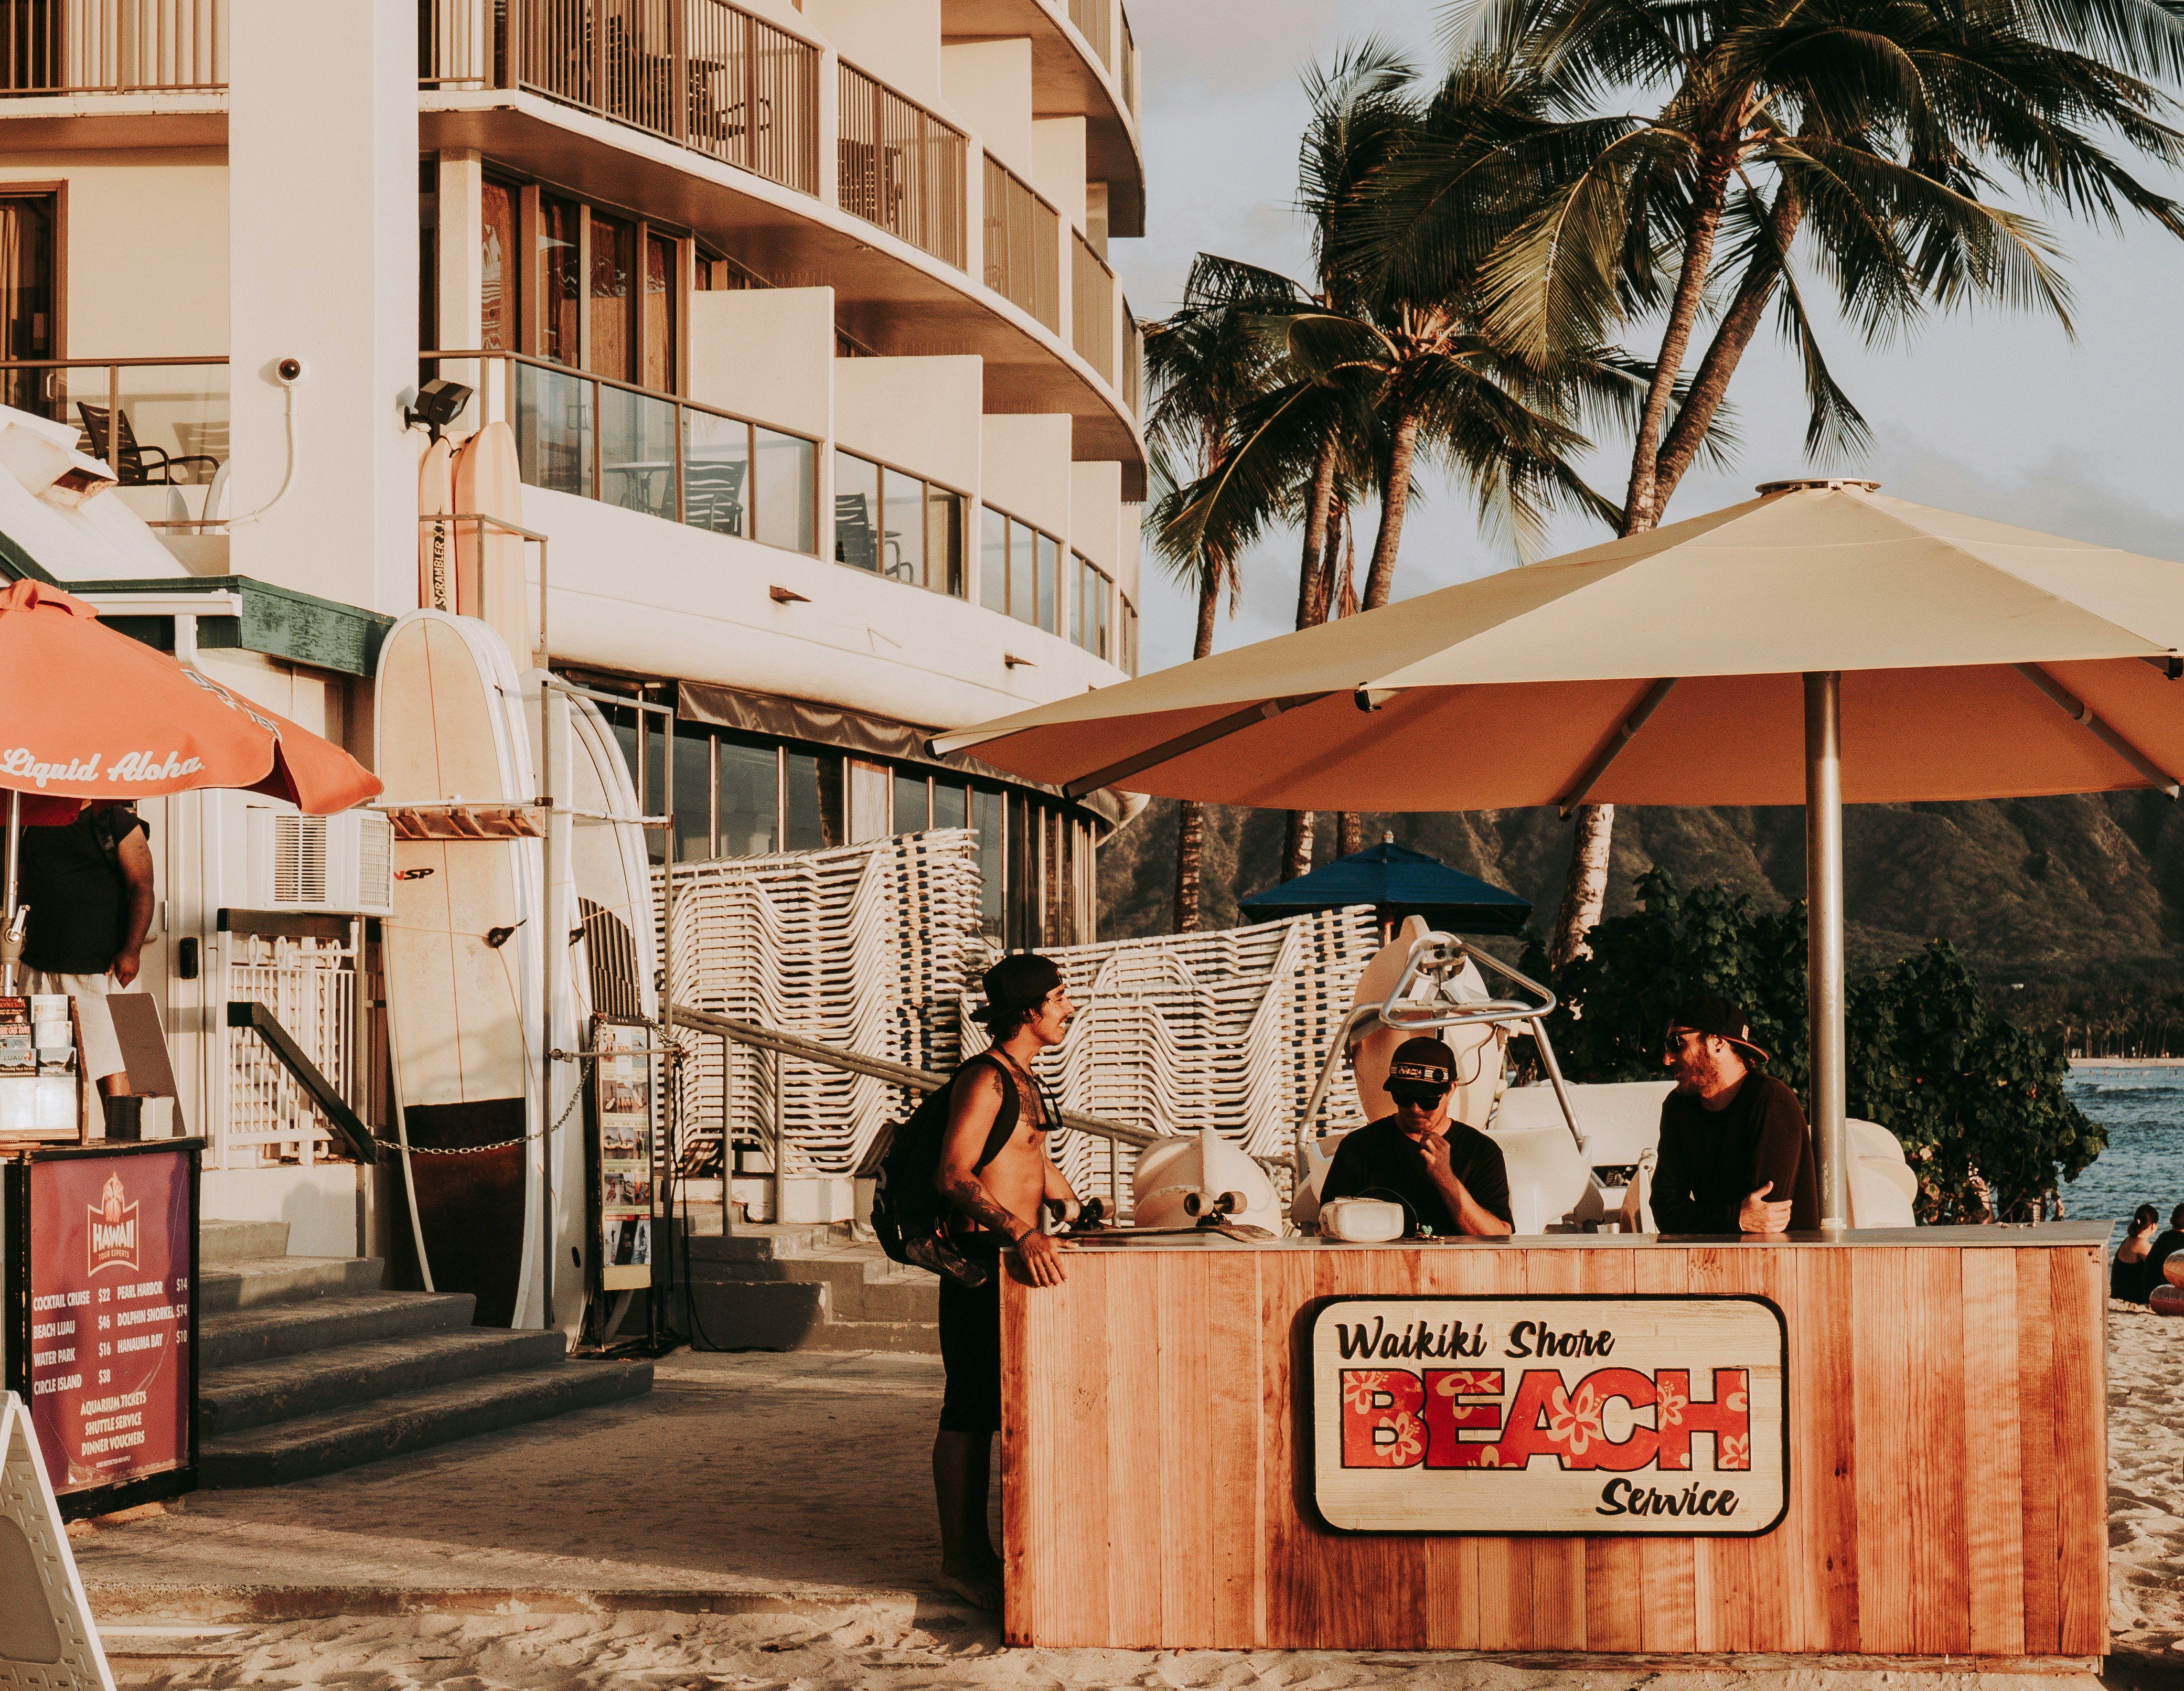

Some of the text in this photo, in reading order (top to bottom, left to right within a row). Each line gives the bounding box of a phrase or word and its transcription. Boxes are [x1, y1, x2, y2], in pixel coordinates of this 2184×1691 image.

[0, 748, 202, 788] Liquid Aloha
[93, 1219, 134, 1253] HAWAII
[98, 1249, 130, 1261] TOUR EXPERTS
[33, 1288, 110, 1311] COCKTAIL CRUISE $22
[117, 1278, 187, 1300] PEARL HARBOR $14
[34, 1315, 110, 1340] BEACH LUAU $46
[117, 1304, 187, 1326] DOLPHIN SNORKEL $74
[117, 1330, 187, 1353] HANAUMA BAY $10
[1334, 1315, 1615, 1360] Waikiki Shore
[34, 1342, 111, 1367] WATER PARK $16
[34, 1369, 111, 1395] CIRCLE ISLAND $38
[80, 1390, 147, 1416] AQUARIUM TICKETS
[85, 1411, 142, 1436] SHUTTLE SERVICE
[1340, 1367, 1751, 1472] BEACH
[81, 1430, 145, 1456] DINNER VOUCHERS
[1596, 1478, 1740, 1517] Service
